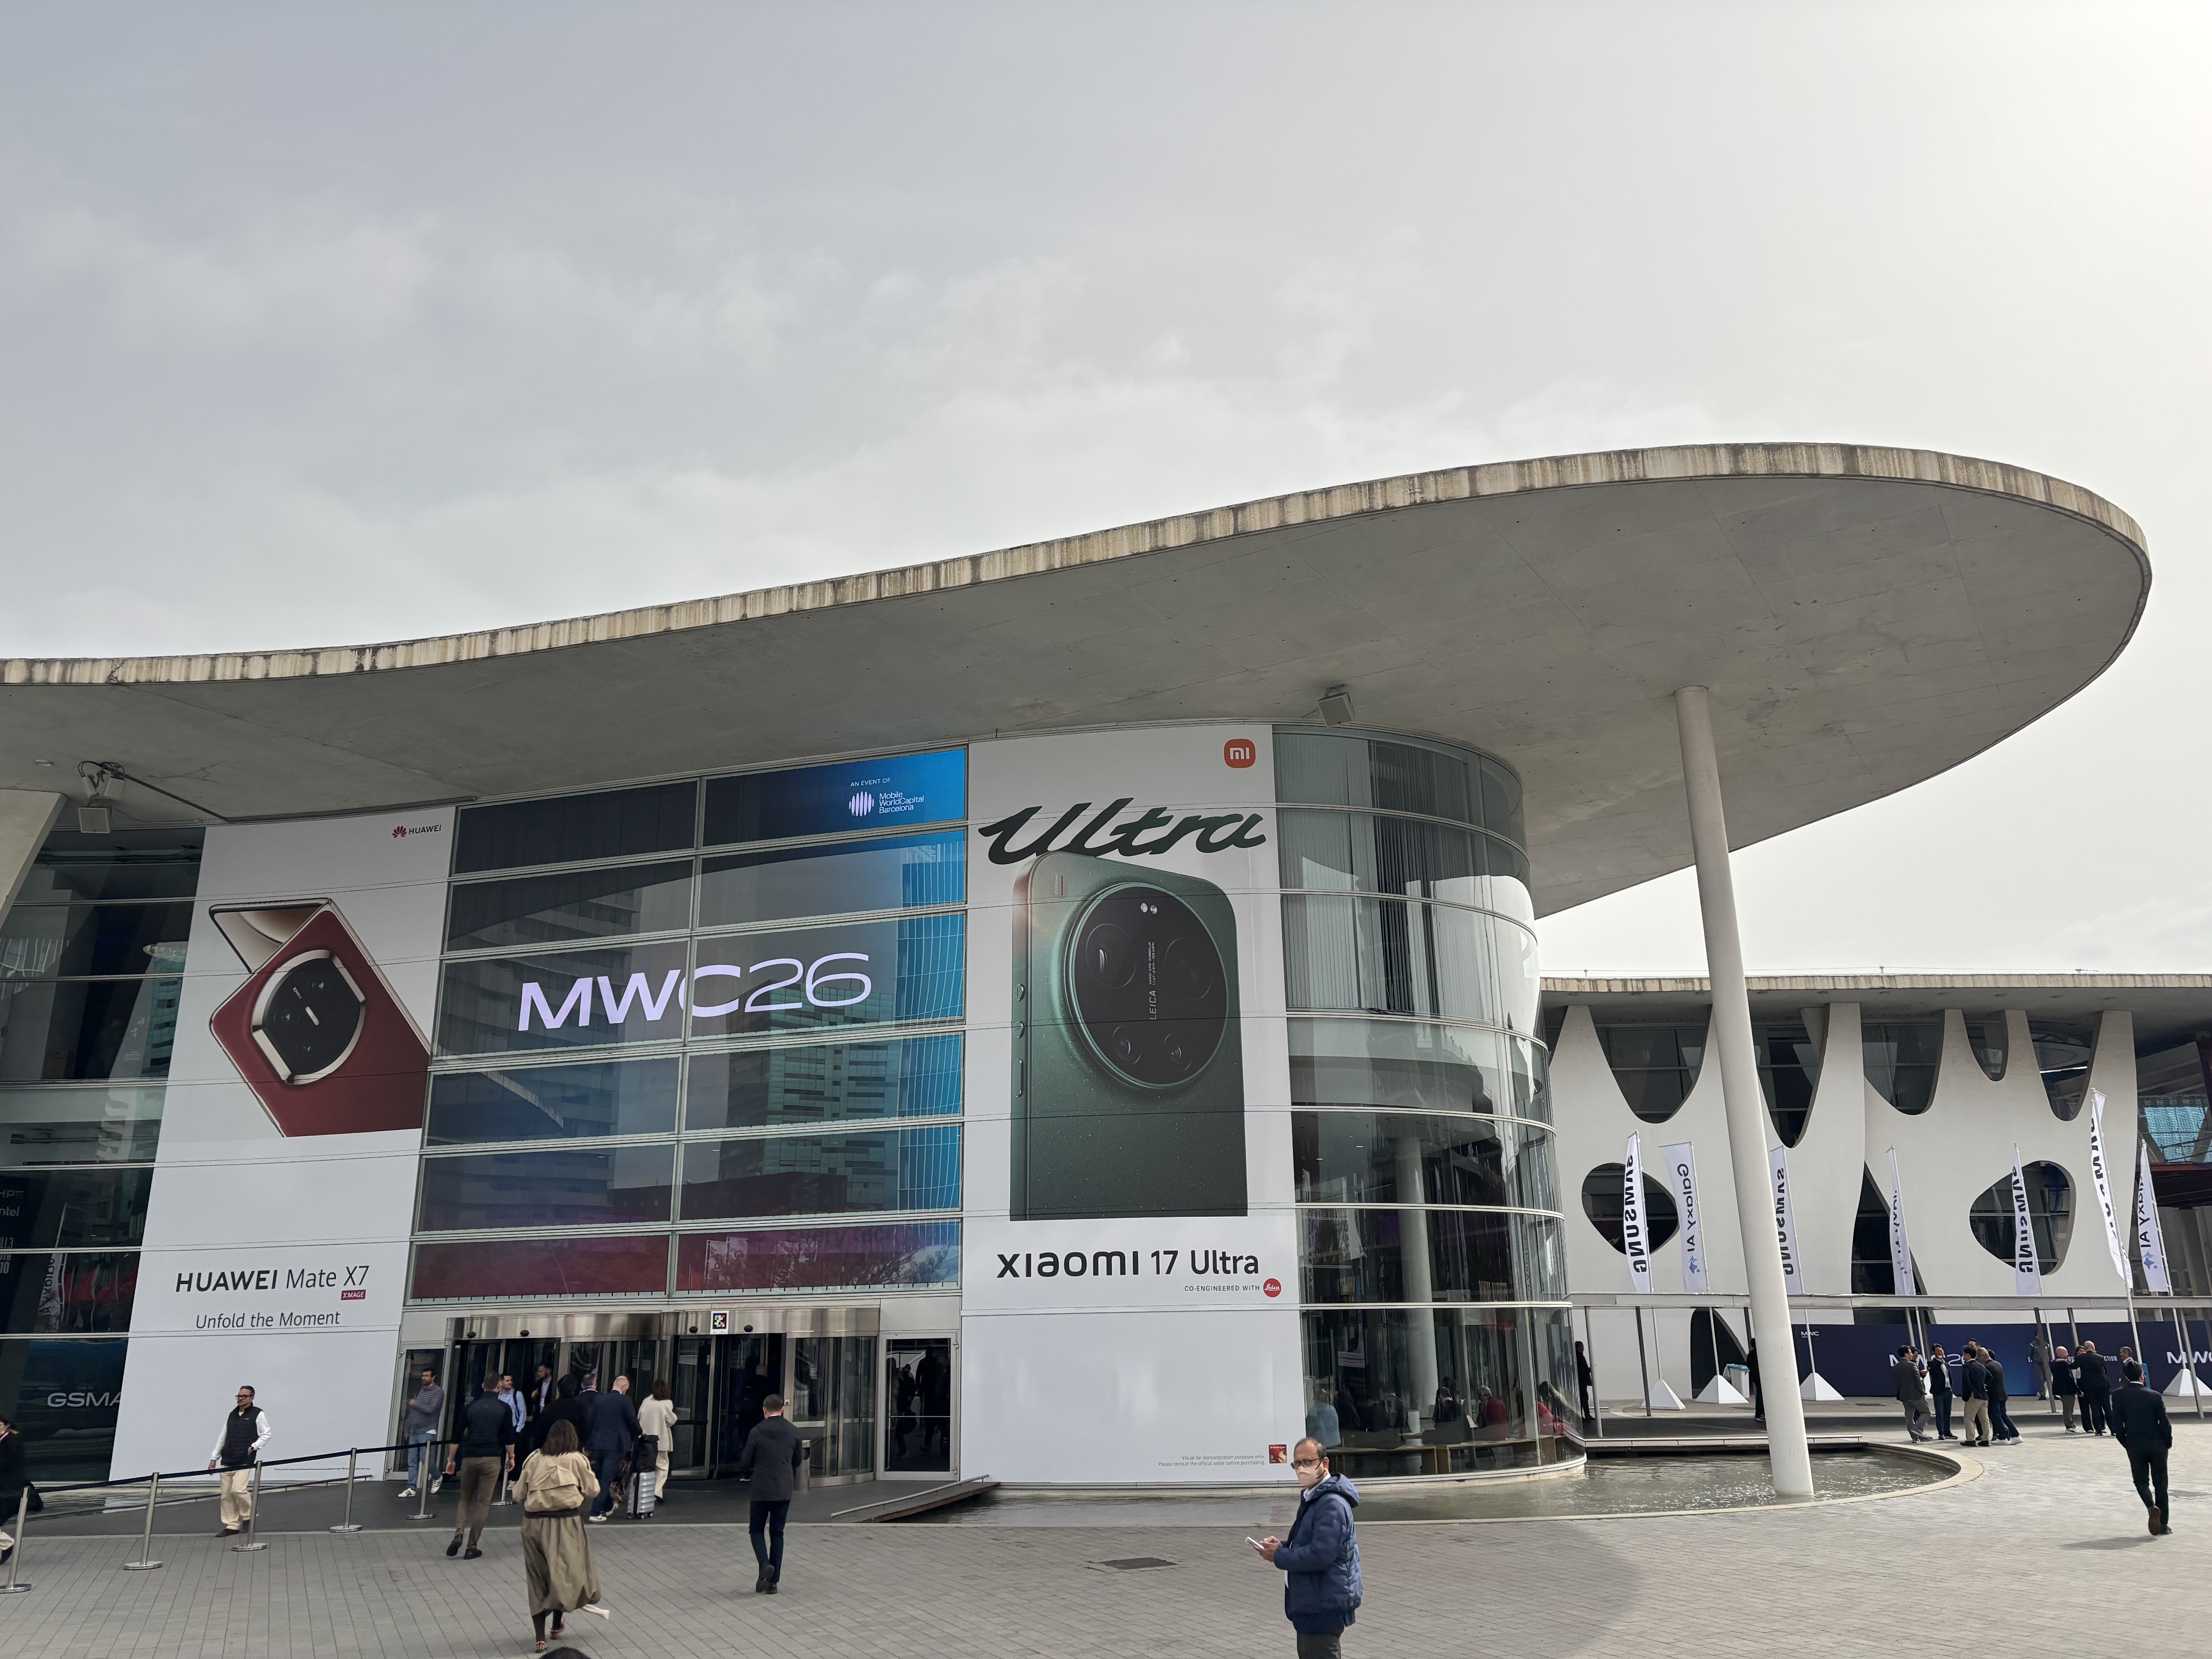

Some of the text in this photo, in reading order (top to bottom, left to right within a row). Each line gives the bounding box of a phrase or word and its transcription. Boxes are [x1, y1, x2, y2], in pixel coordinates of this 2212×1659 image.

[879, 791, 903, 800] Mobile
[879, 795, 924, 807] WorldCapital
[879, 805, 914, 814] Barcelona
[409, 825, 441, 834] HUAWEI
[978, 797, 1266, 865] Ultra
[518, 952, 872, 1031] MWC26
[0, 1207, 19, 1217] ntel
[1151, 1250, 1179, 1274] 17
[1191, 1250, 1259, 1275] Ultra
[175, 1266, 369, 1292] HUAWEI Mate X7
[1264, 1283, 1280, 1291] Leica
[196, 1311, 340, 1329] Unfold the Moment
